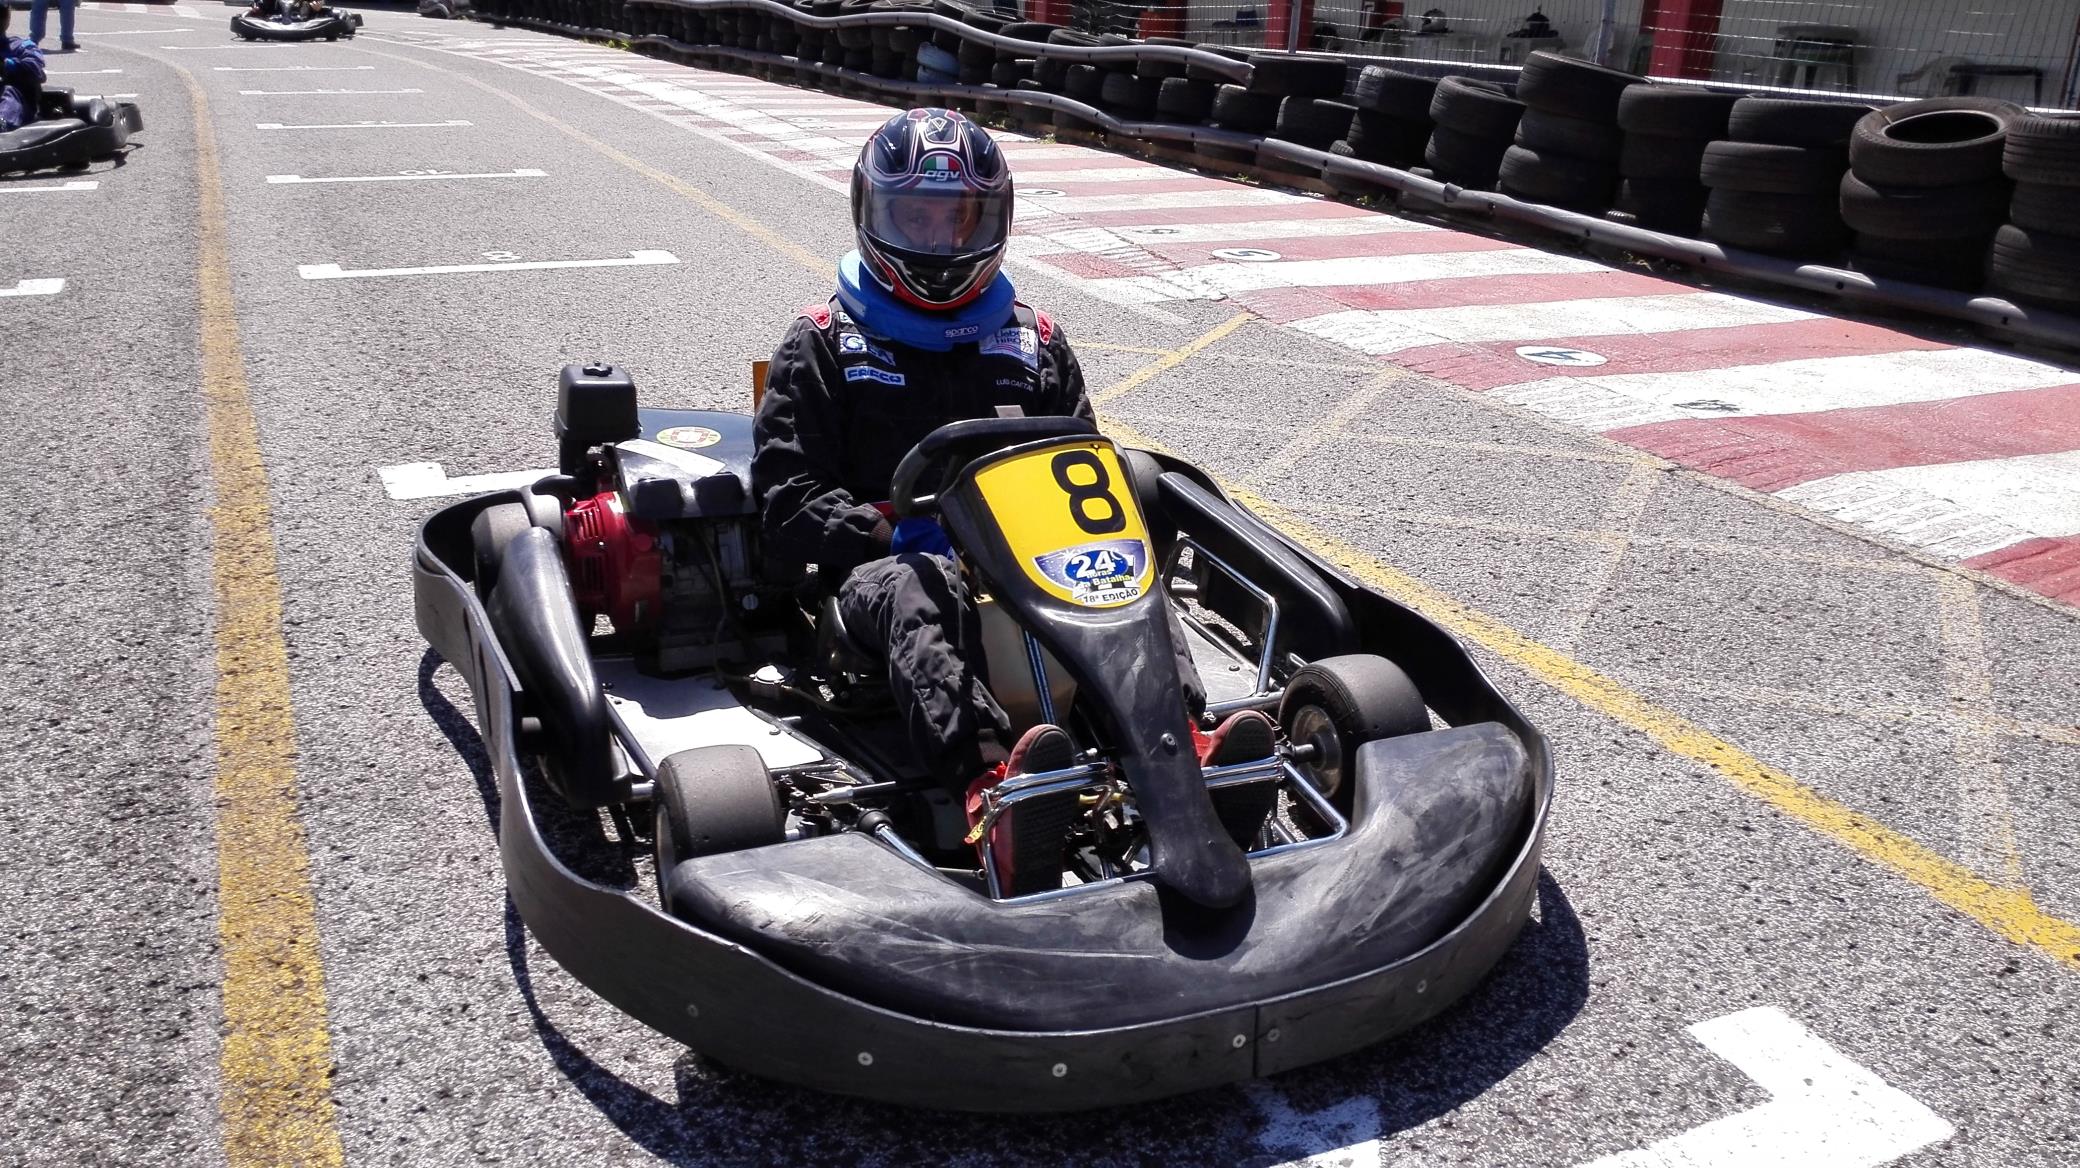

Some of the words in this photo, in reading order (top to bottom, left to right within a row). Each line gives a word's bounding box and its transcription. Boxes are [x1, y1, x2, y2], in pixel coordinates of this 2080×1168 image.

[925, 170, 960, 182] agv
[945, 325, 978, 338] sparco
[1051, 450, 1126, 534] 8
[1071, 550, 1116, 579] 24
[1092, 573, 1131, 586] Batalha
[1102, 587, 1138, 602] EDIÇÃO
